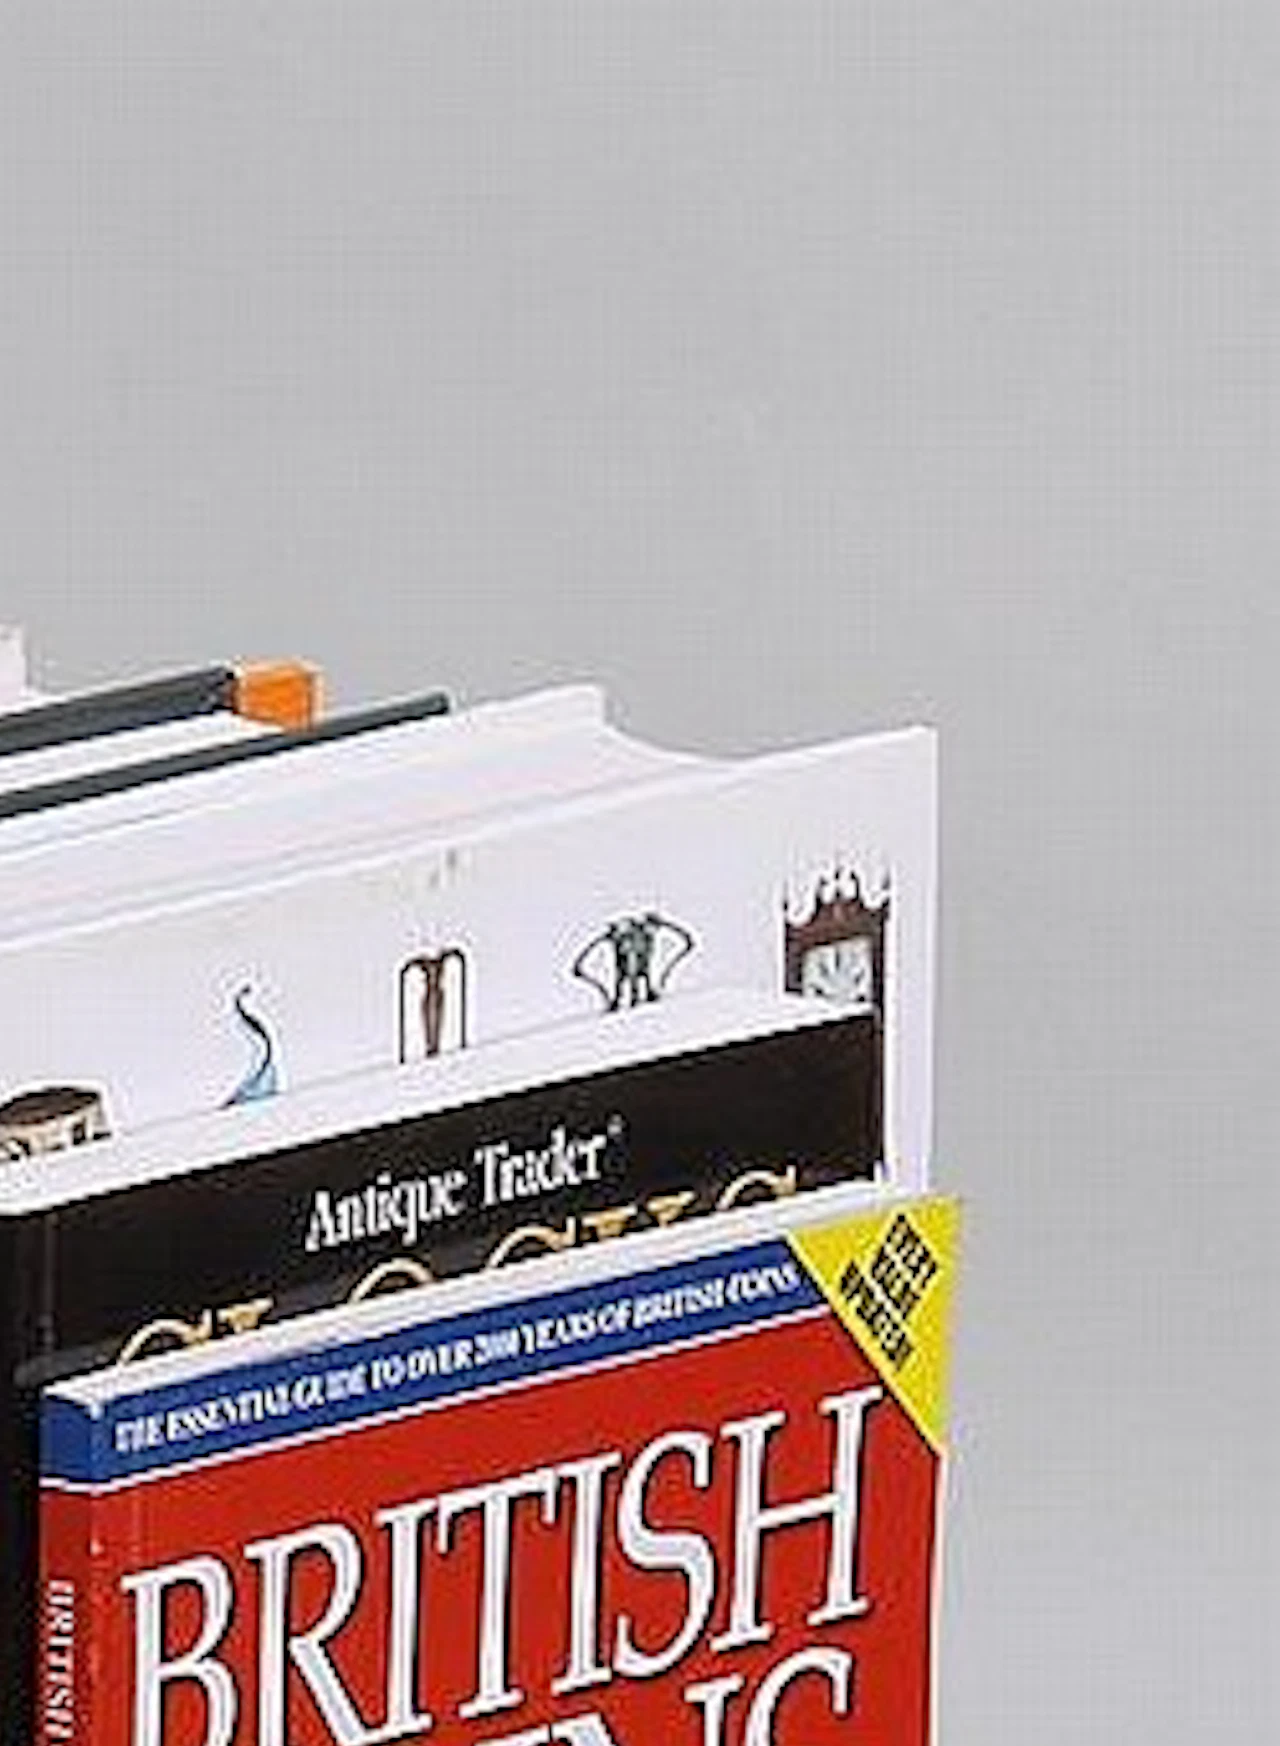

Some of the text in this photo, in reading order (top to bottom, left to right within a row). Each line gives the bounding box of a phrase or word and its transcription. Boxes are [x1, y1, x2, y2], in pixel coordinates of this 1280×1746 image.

[304, 1166, 469, 1252] Antique
[370, 1355, 405, 1390] TO
[407, 1337, 474, 1381] OVER
[522, 1309, 597, 1358] YEARS
[598, 1300, 632, 1336] OF
